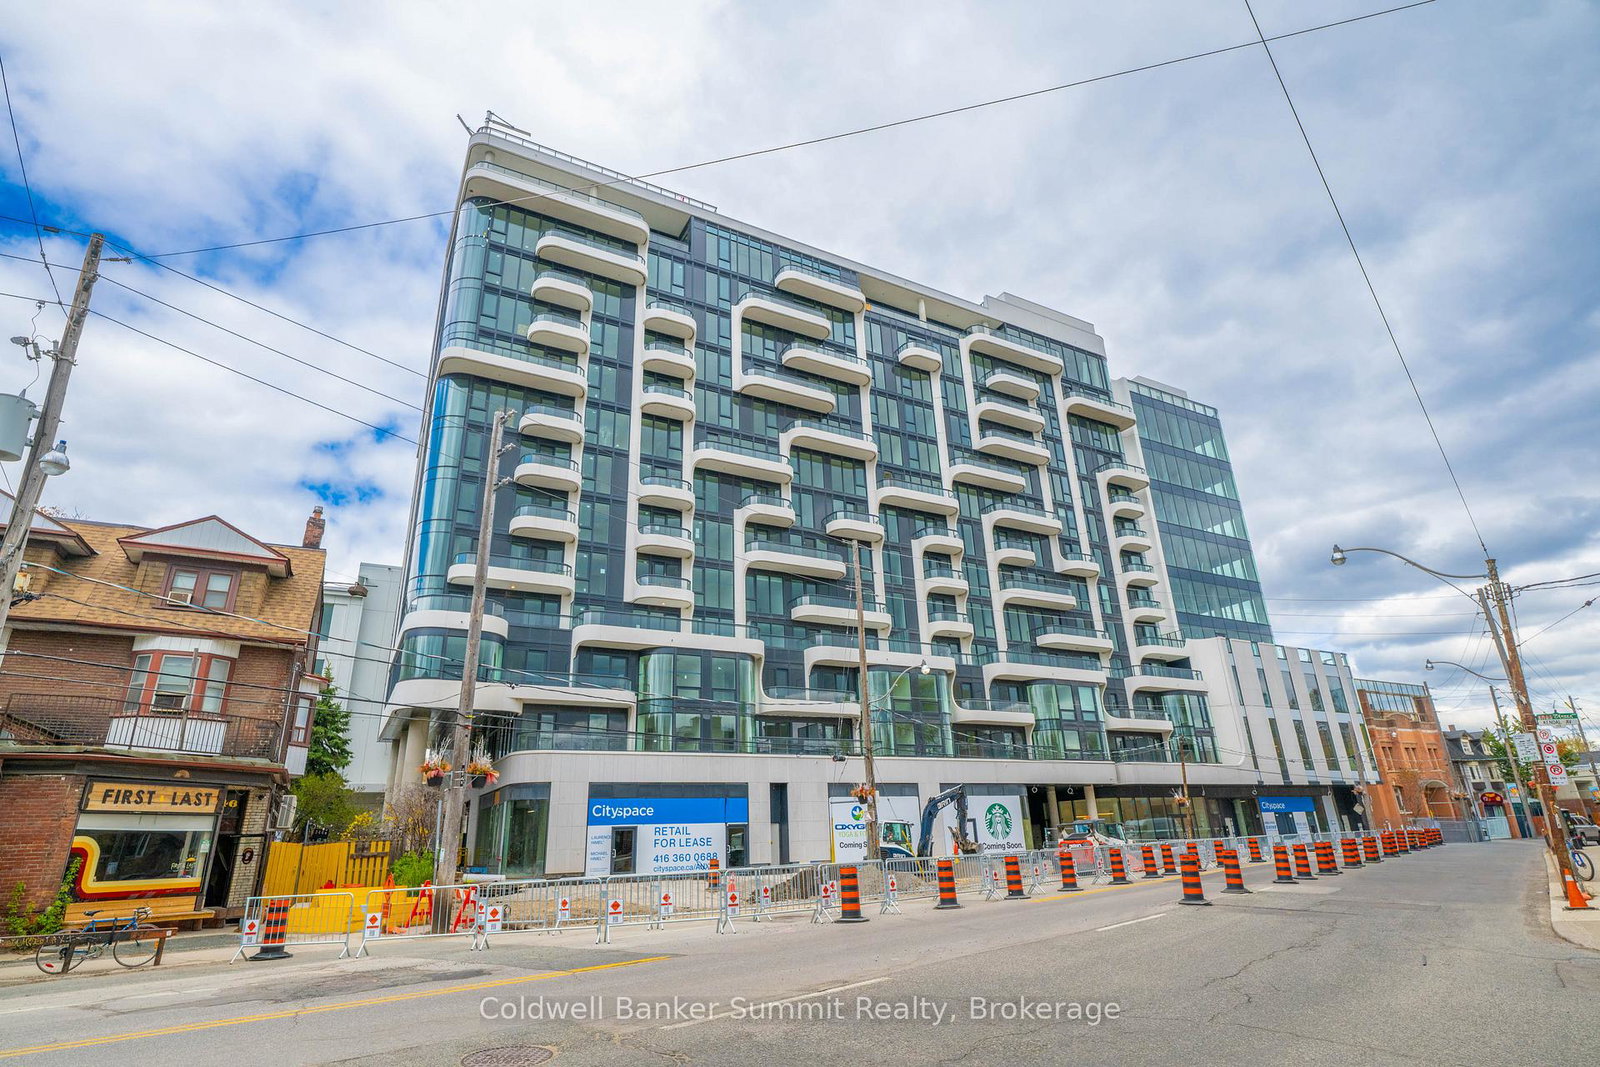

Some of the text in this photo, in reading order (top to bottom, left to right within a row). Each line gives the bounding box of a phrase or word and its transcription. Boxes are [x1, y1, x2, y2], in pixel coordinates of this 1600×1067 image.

[101, 788, 213, 807] FIRST LAST
[592, 804, 654, 819] Cityspace
[654, 826, 691, 836] RETAIL
[653, 837, 712, 848] FOR LEASE
[839, 841, 863, 849] Coming
[653, 852, 718, 863] 416 360 0688
